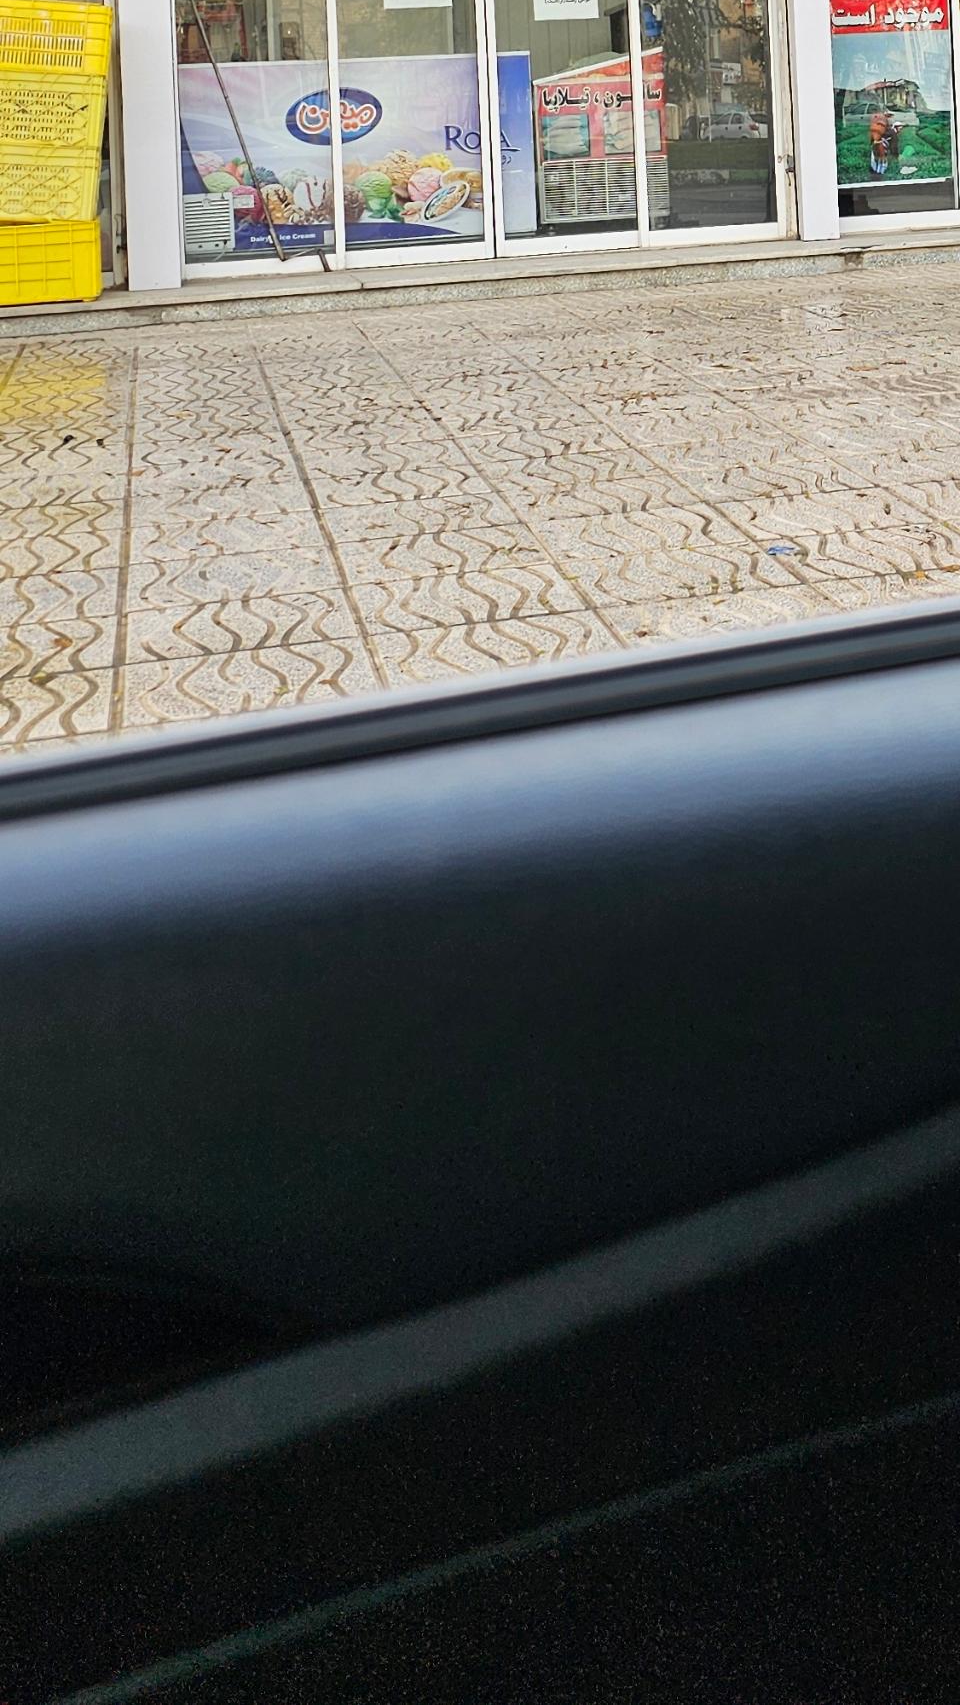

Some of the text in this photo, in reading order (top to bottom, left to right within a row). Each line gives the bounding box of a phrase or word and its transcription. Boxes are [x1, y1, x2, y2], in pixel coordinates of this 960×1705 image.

[831, 3, 944, 29] موجود است
[542, 86, 590, 113] تیلاپیا
